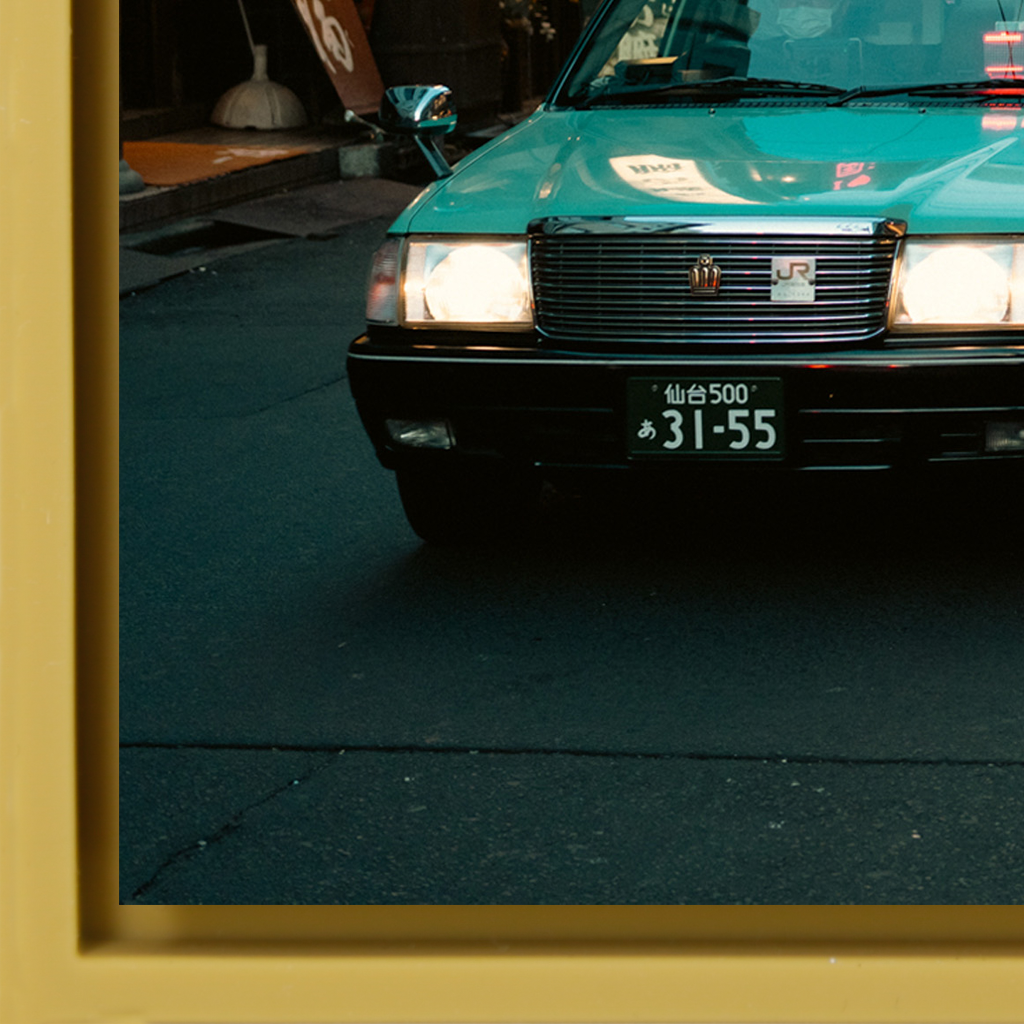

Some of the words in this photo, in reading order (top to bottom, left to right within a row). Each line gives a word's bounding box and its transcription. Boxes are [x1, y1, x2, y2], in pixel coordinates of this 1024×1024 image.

[776, 262, 810, 281] JR
[636, 418, 658, 441] あ
[661, 408, 777, 450] 31-55
